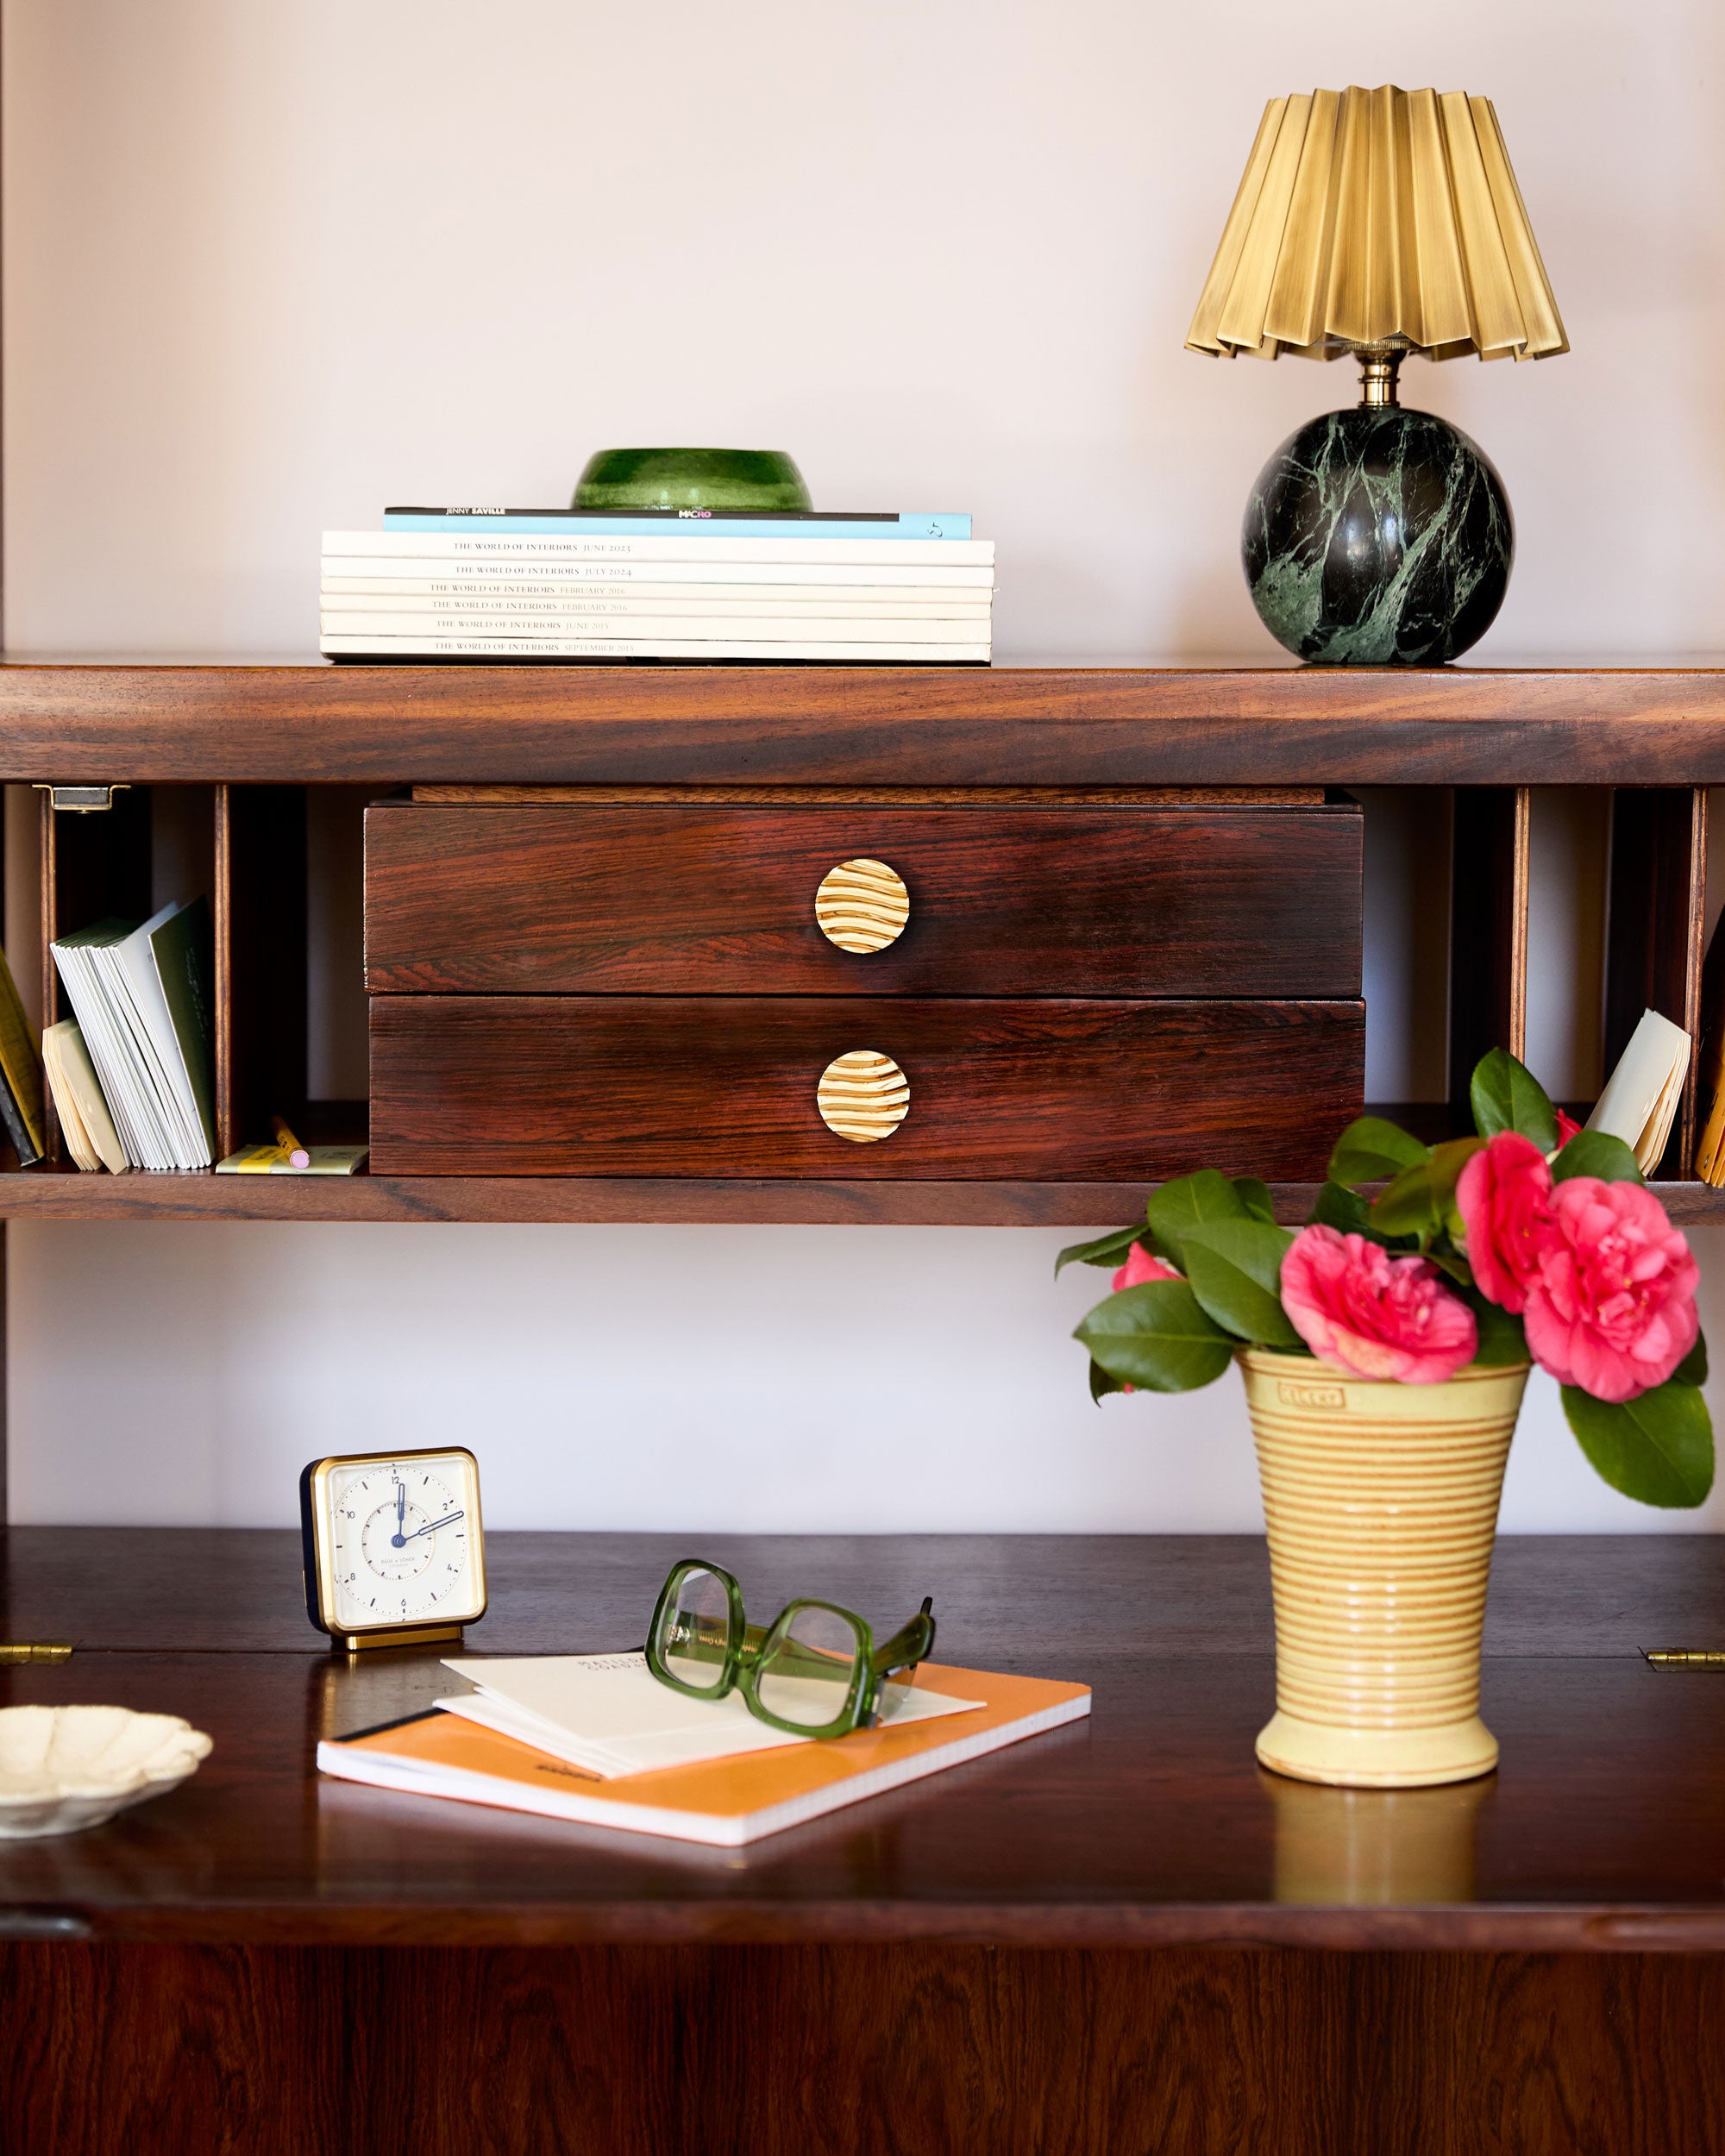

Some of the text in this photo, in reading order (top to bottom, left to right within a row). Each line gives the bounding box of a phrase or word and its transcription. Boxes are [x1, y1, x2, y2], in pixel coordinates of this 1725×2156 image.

[609, 568, 631, 577] 2024
[562, 603, 607, 611] FEBRUARY
[565, 622, 590, 630] JUNE
[442, 1502, 448, 1511] 2
[347, 1511, 355, 1520] 10
[401, 1598, 406, 1607] 6
